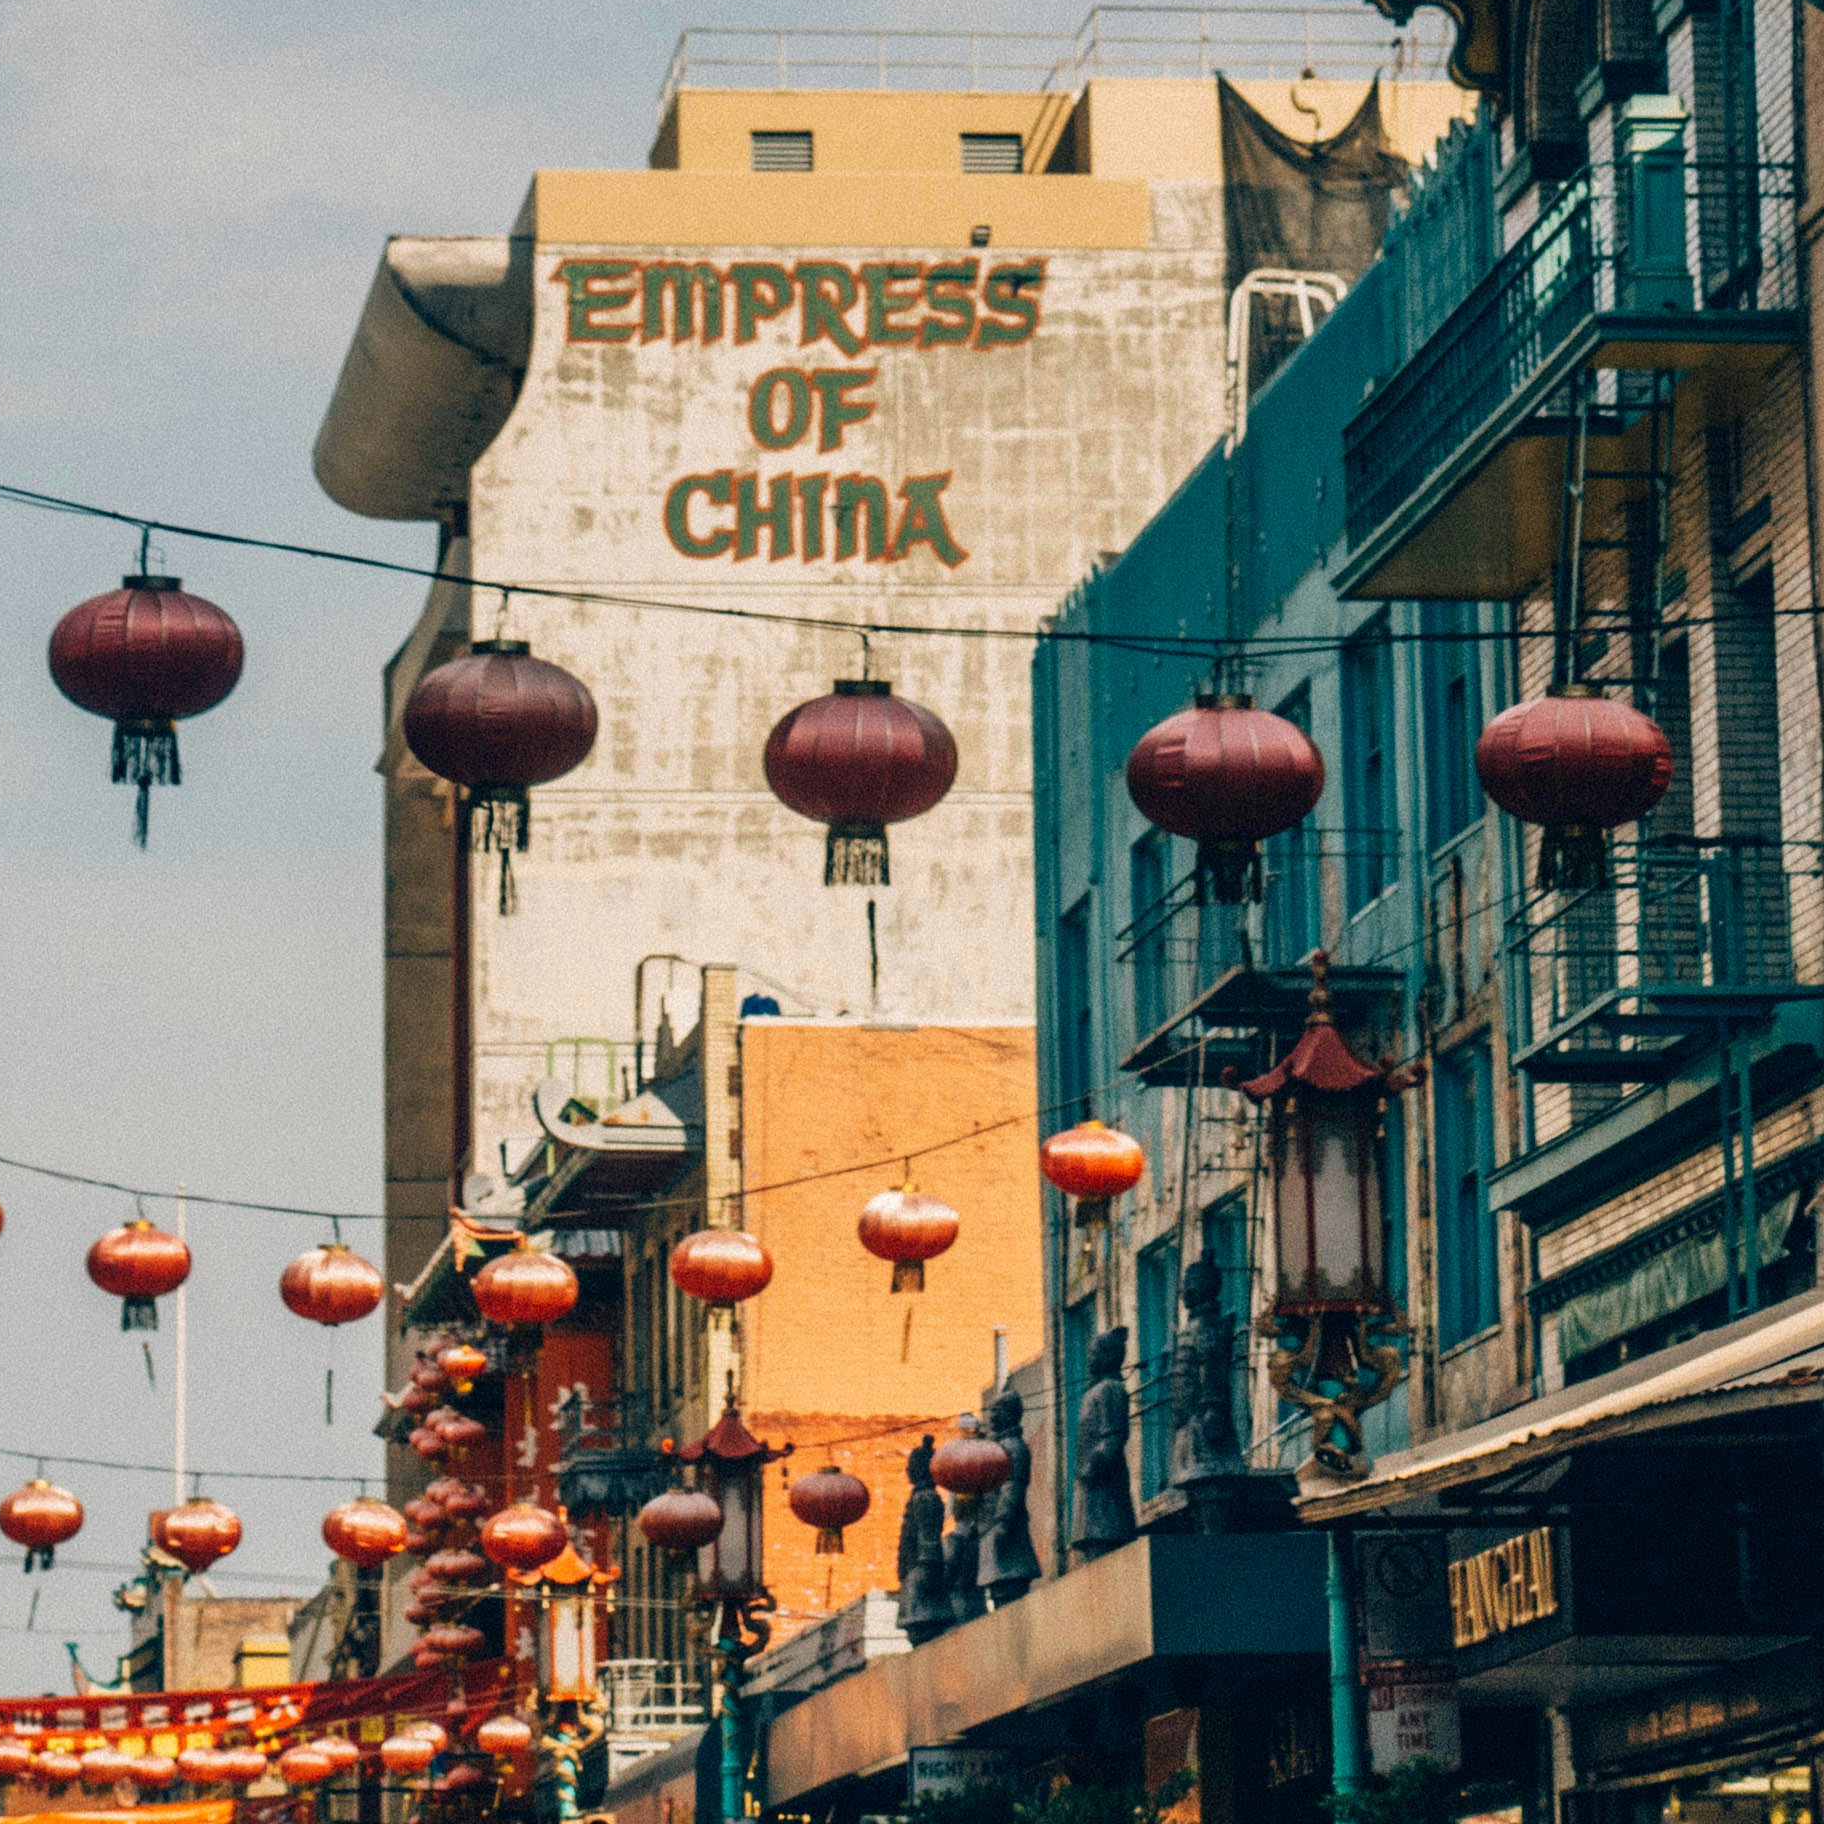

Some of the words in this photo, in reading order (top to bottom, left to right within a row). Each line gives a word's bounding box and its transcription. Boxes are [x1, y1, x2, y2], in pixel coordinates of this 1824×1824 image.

[551, 256, 1046, 357] EMPRESS
[748, 366, 878, 454] OF
[663, 469, 970, 569] CHINA
